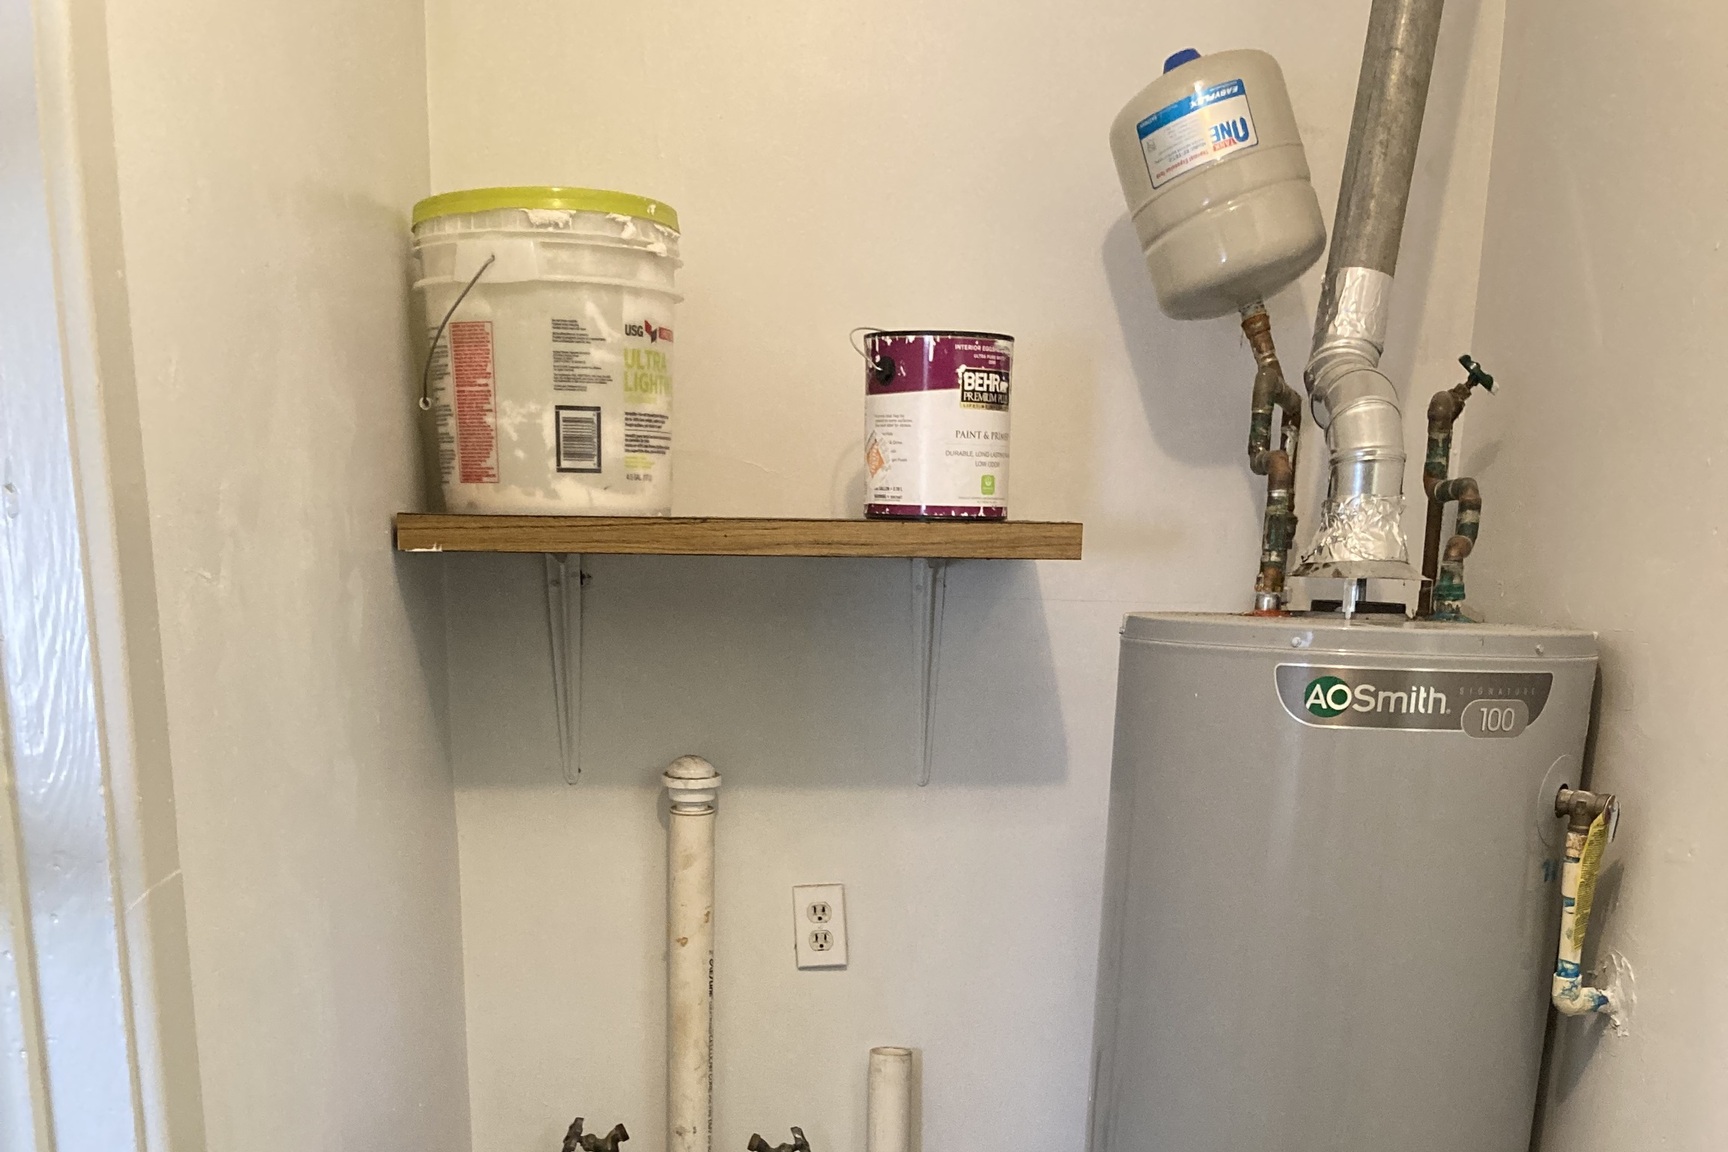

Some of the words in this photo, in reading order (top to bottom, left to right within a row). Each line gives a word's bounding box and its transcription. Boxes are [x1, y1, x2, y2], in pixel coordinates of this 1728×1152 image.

[624, 324, 644, 337] USG
[963, 371, 1000, 393] BEHR
[955, 430, 981, 440] PAINT
[983, 431, 989, 440] &
[1460, 686, 1535, 696] SIGNATURE
[1480, 707, 1515, 732] 100
